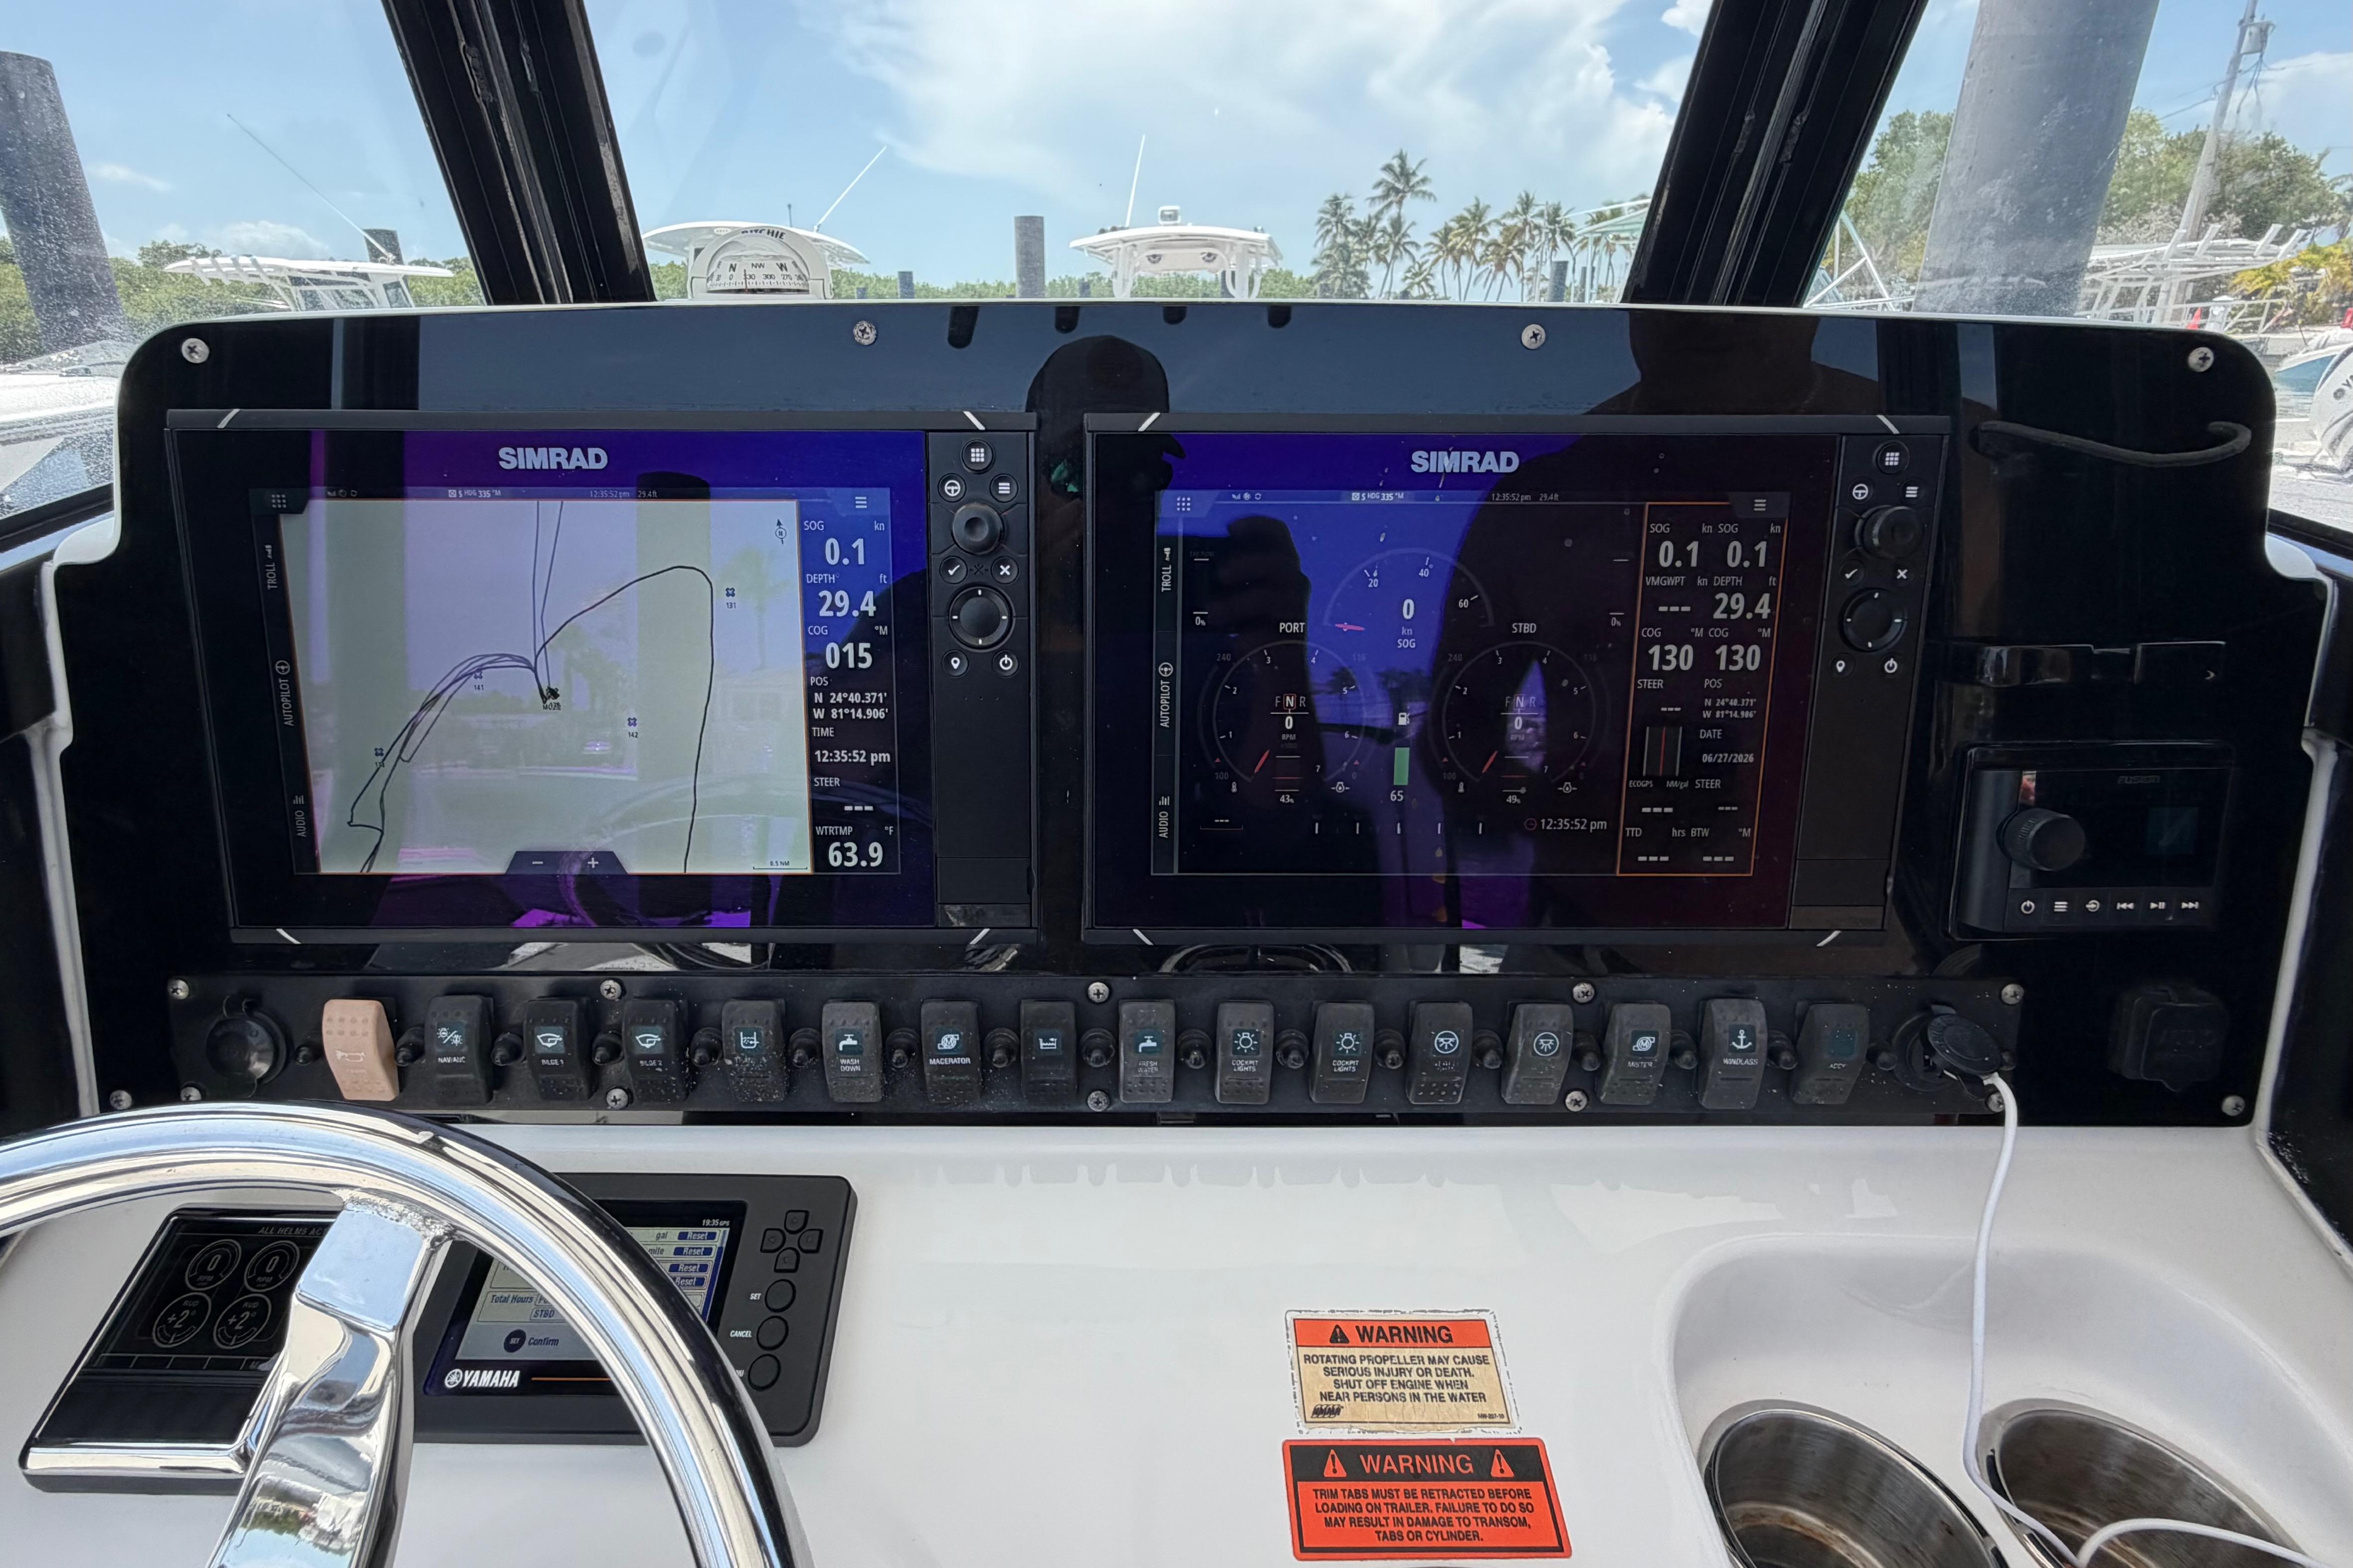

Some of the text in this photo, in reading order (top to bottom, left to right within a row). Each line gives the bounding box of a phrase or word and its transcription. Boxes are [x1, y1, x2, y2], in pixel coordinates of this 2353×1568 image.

[776, 263, 788, 272] W
[499, 448, 608, 470] SIMRAD
[1411, 451, 1520, 473] SIMRAD
[804, 520, 885, 531] SOG kn
[1649, 523, 1713, 533] SOG kn
[1718, 523, 1781, 533] SOG kn
[825, 538, 866, 565] 0.1
[1659, 540, 1699, 568] 0.1
[1727, 540, 1767, 568] 0.1
[265, 562, 278, 590] TROLL
[1419, 568, 1429, 577] 40
[806, 573, 888, 584] DEPTH ft
[1161, 565, 1172, 592] TROLL
[1368, 578, 1378, 588] 20
[1645, 576, 1708, 586] VMGWPT kn
[1713, 576, 1777, 586] DEPTH ft
[818, 590, 877, 617] 29.4
[1402, 598, 1415, 619] 0
[1458, 598, 1469, 608] 60
[1713, 593, 1771, 619] 29.4
[808, 624, 888, 636] COG °M
[1280, 622, 1305, 633] PORT
[1402, 626, 1413, 636] kn
[1512, 623, 1537, 634] STBD
[1641, 628, 1662, 637] COG
[1709, 628, 1729, 637] COG
[1397, 639, 1416, 649] SOG
[825, 642, 873, 670] 015
[1648, 644, 1694, 671] 130
[1716, 644, 1761, 671] 130
[811, 677, 828, 686] POS
[1637, 680, 1663, 688] STEER
[1704, 679, 1722, 688] POS
[279, 678, 294, 726] AUTOPILOT
[814, 692, 888, 703] N 24°40.371'
[1160, 680, 1170, 728] AUTOPILOT
[813, 708, 889, 719] W 81°14.906'
[812, 727, 835, 737] TIME
[1700, 729, 1723, 739] DATE
[815, 750, 891, 766] 12:35:52 pm
[1702, 753, 1754, 763] 06/27/2026
[814, 778, 840, 787] STEER
[1695, 779, 1721, 788] STEER
[1390, 790, 1404, 801] 65
[295, 810, 307, 837] AUDIO
[1158, 811, 1168, 838] AUDIO
[1540, 818, 1607, 832] 12:35:52 pm
[816, 826, 894, 836] WTRTMP °F
[1625, 827, 1686, 837] TTD hrs
[1691, 828, 1710, 837] BTW
[828, 842, 884, 867] 63.9
[277, 1227, 307, 1236] HELMS
[656, 1232, 668, 1241] gal
[678, 1264, 700, 1273] Reset
[675, 1277, 697, 1285] Reset
[491, 1295, 510, 1303] Total
[511, 1295, 534, 1303] Hours
[533, 1309, 555, 1318] STBD
[1355, 1325, 1454, 1343] WARNING
[527, 1337, 559, 1346] Confirm
[1304, 1354, 1490, 1366] ROTATING PROPELLER MAY CAUSE
[1323, 1367, 1475, 1377] SERIOUS INJURY OR DEATH.
[461, 1370, 521, 1388] YAMAHA
[1333, 1379, 1469, 1390] SHUT OFF ENGINE WHEN
[1320, 1392, 1487, 1402] NEAR PERSONS IN THE WATER
[1359, 1455, 1473, 1474] WARNING
[1313, 1488, 1532, 1499] TRIM TABS MUST BE RETRACTED BEFORE
[1315, 1503, 1535, 1514] LOADING ON TRAILER. FAILURE TO DO SO
[1325, 1517, 1532, 1529] MAY RESULT IN DAMAGE TO TRANSOM,
[1375, 1530, 1484, 1542] TABS OR CYLINDER.
